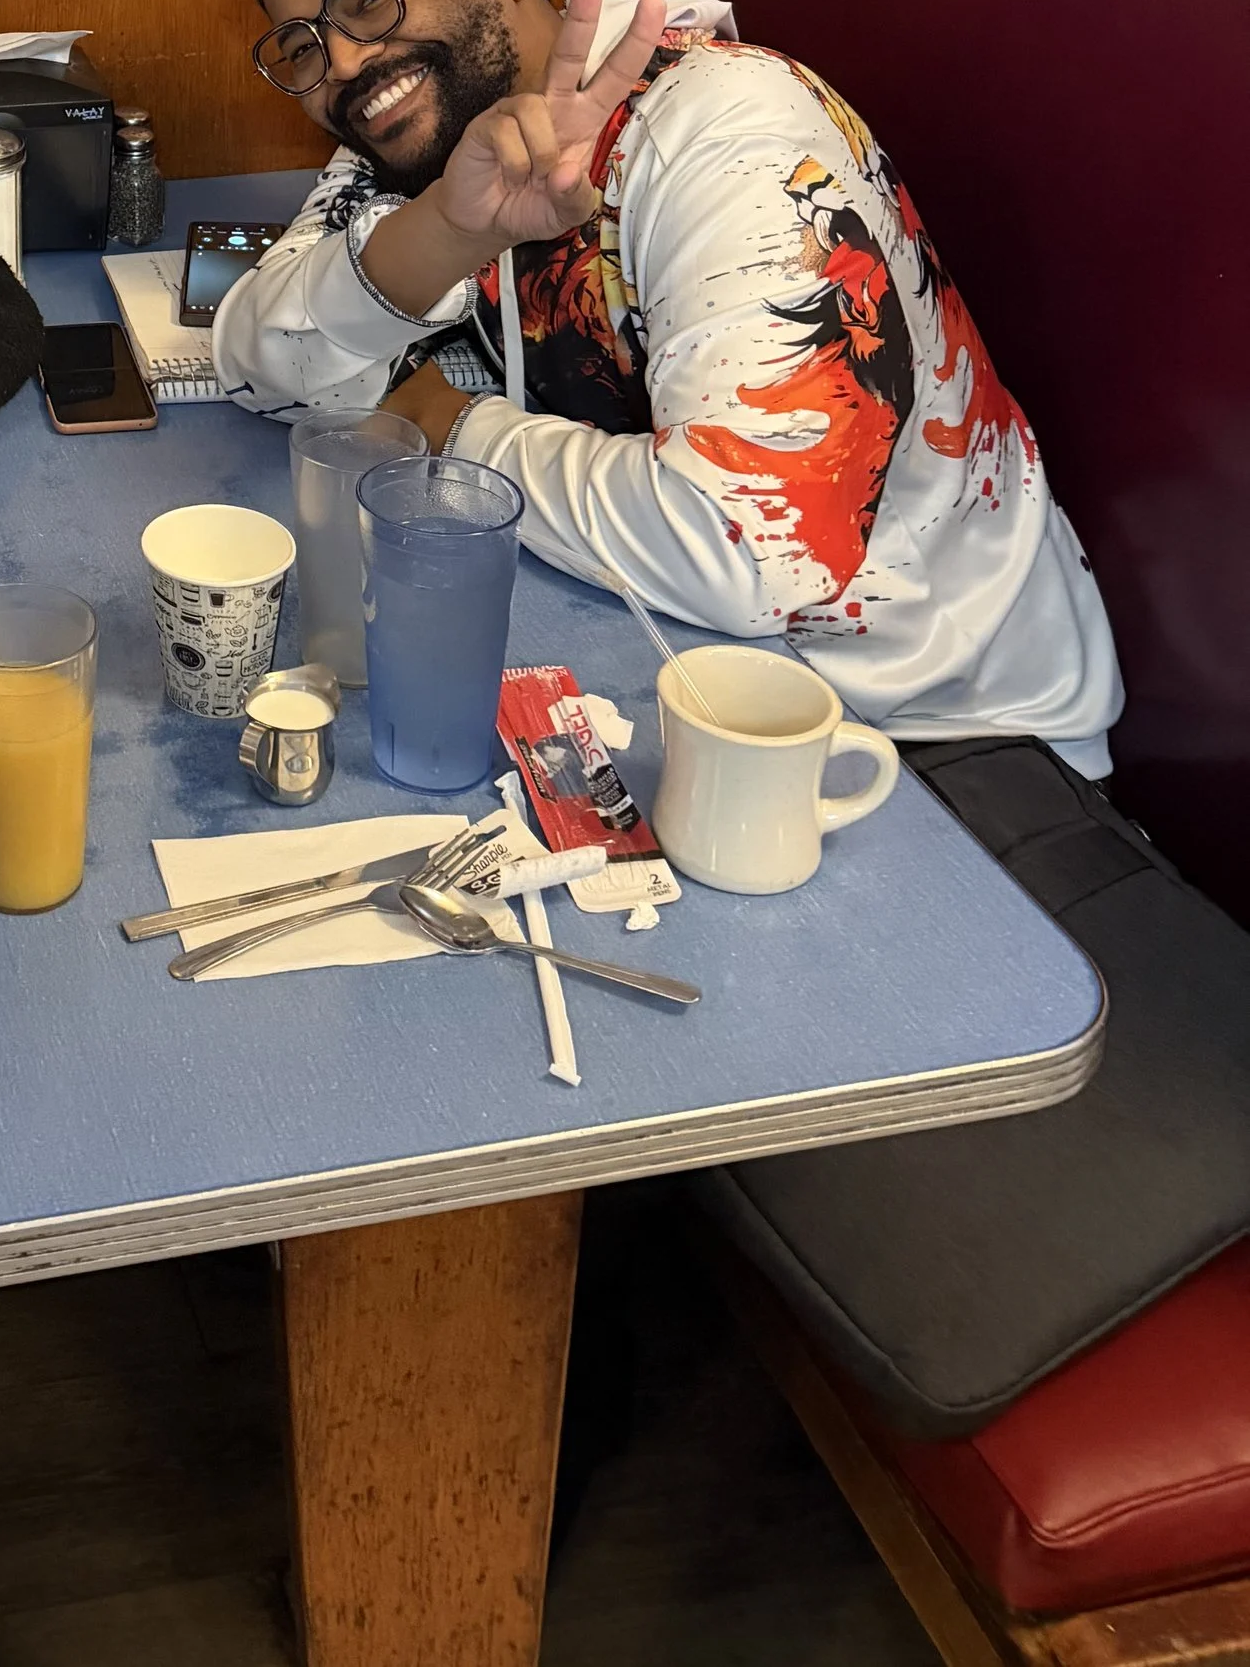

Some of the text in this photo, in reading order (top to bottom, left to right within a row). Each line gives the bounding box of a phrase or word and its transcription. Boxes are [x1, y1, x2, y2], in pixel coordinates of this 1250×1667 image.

[65, 106, 105, 118] VALAY
[463, 843, 509, 883] Sharpie
[650, 873, 662, 885] 2
[647, 882, 672, 893] METAL
